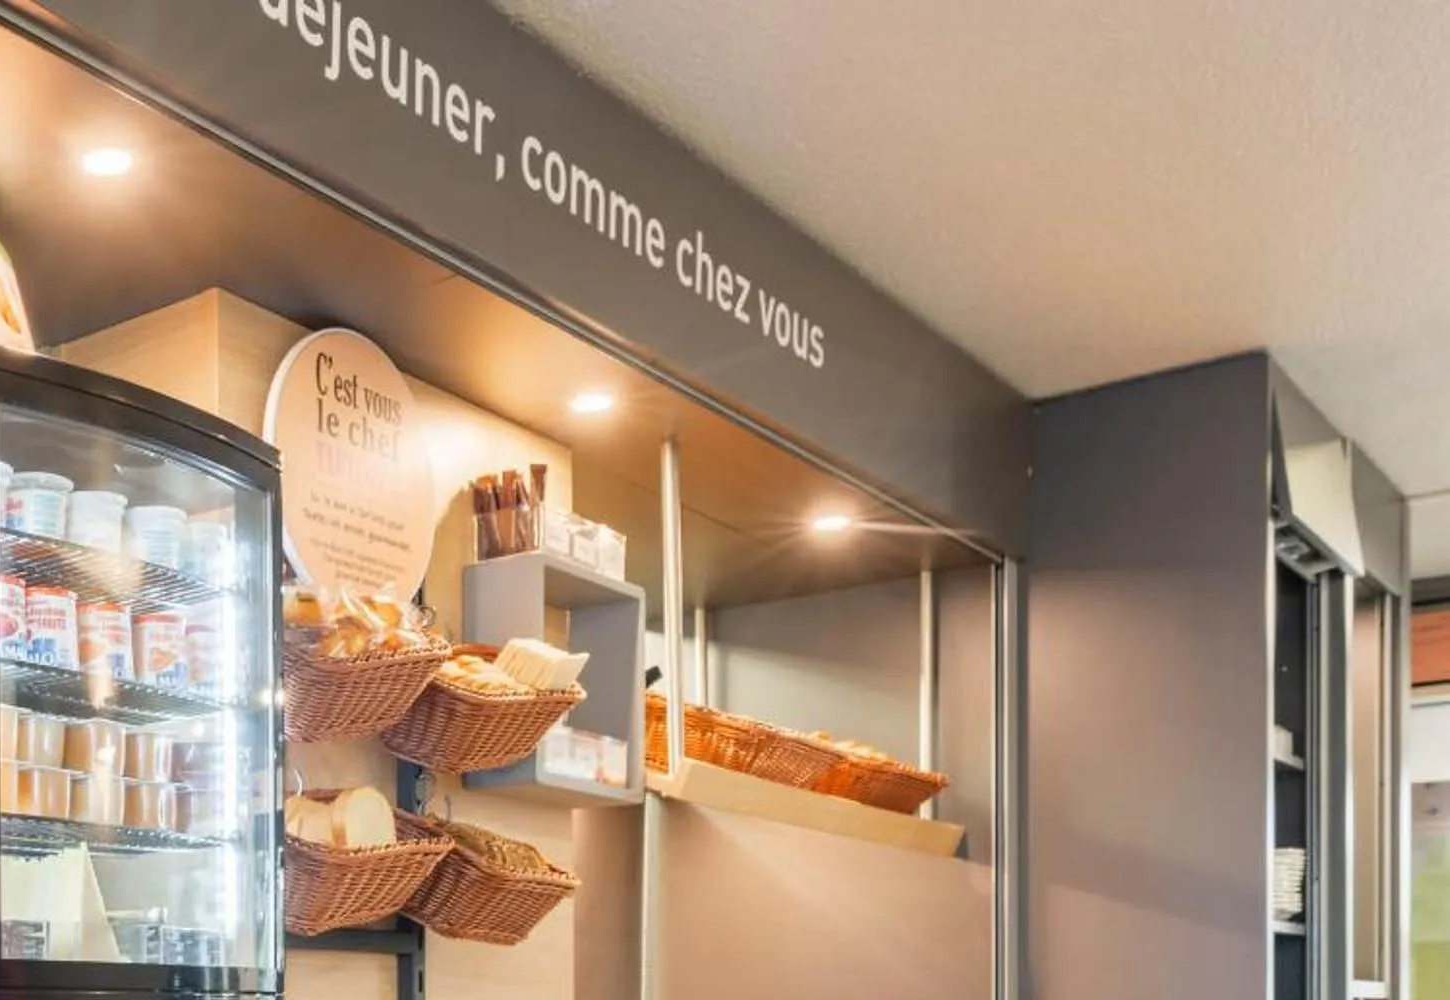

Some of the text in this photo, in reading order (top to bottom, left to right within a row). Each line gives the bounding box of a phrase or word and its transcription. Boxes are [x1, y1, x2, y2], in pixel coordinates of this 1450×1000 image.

[521, 135, 666, 268] comme
[676, 230, 751, 324] chez
[758, 287, 825, 369] vous
[315, 351, 402, 423] C'est vous
[316, 396, 340, 438] le
